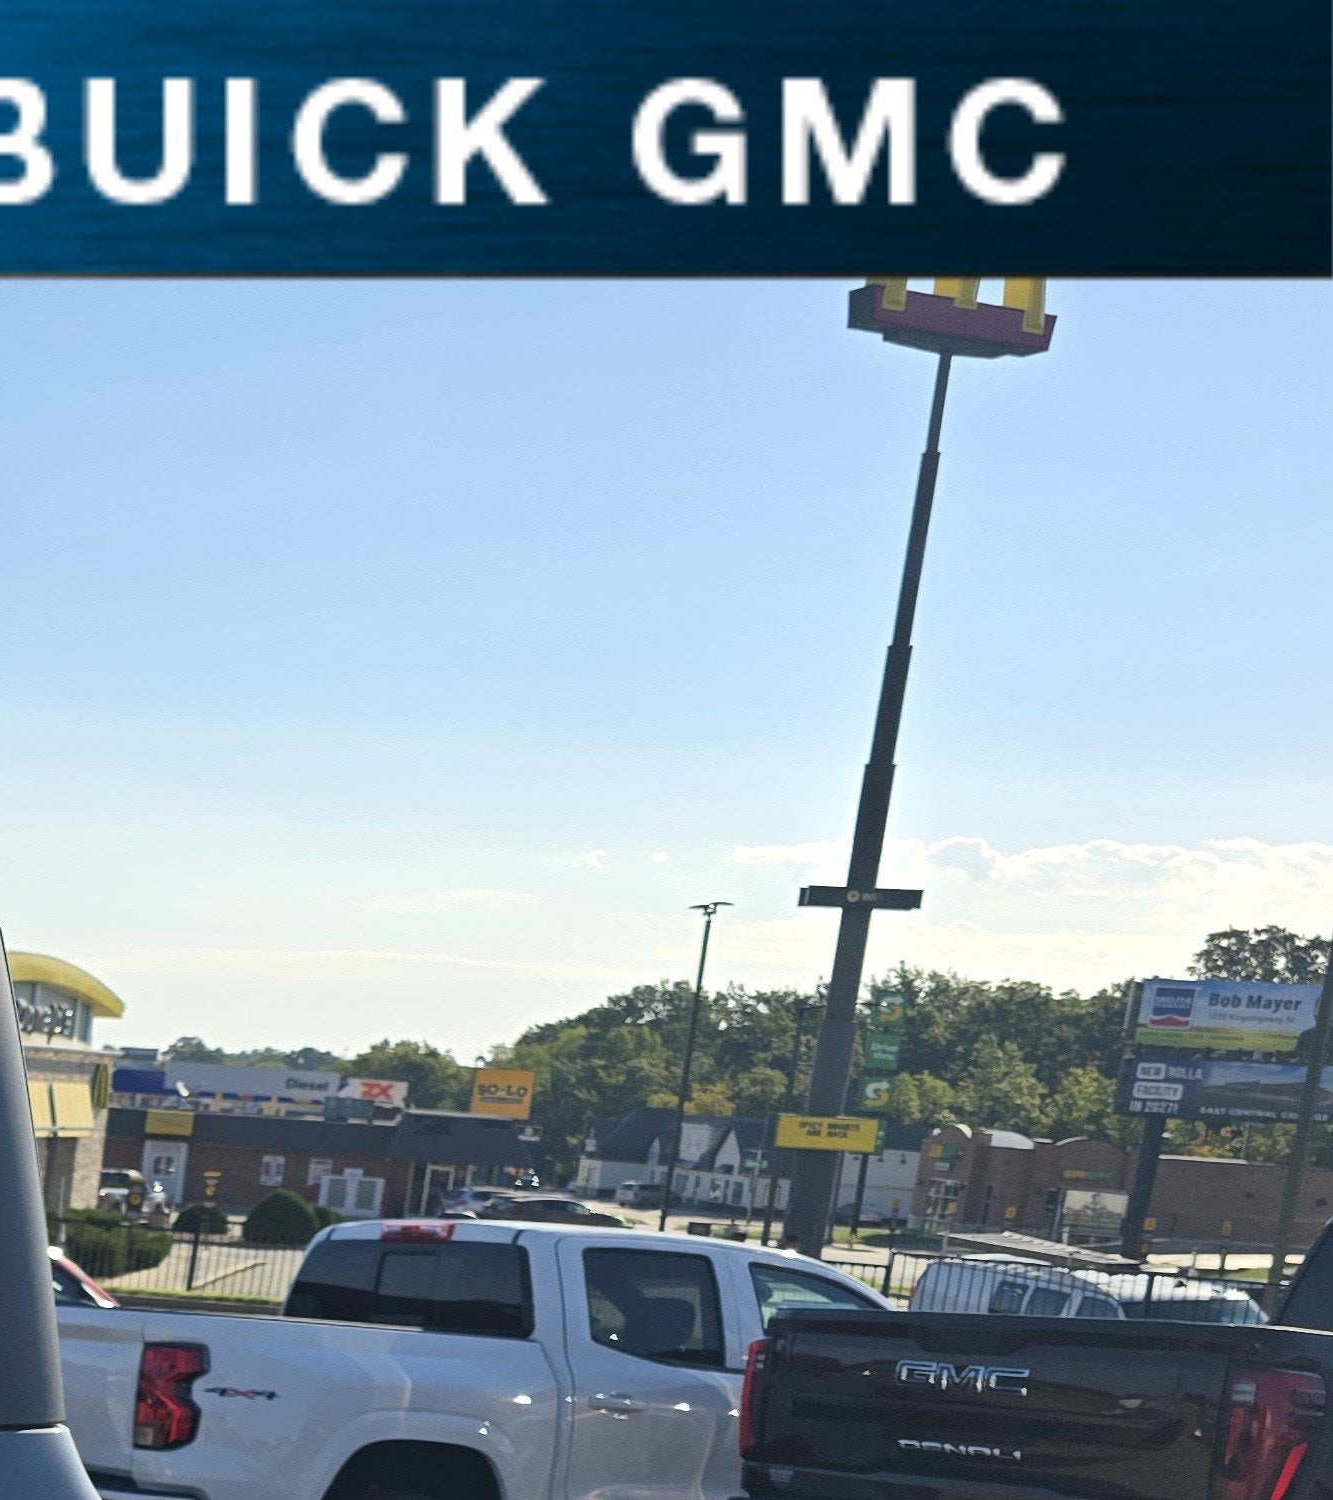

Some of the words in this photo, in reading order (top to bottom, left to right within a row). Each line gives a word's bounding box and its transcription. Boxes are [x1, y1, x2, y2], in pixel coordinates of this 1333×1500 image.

[1208, 992, 1242, 1008] Bob
[1246, 994, 1303, 1013] Mayer
[895, 1359, 1031, 1397] GMC
